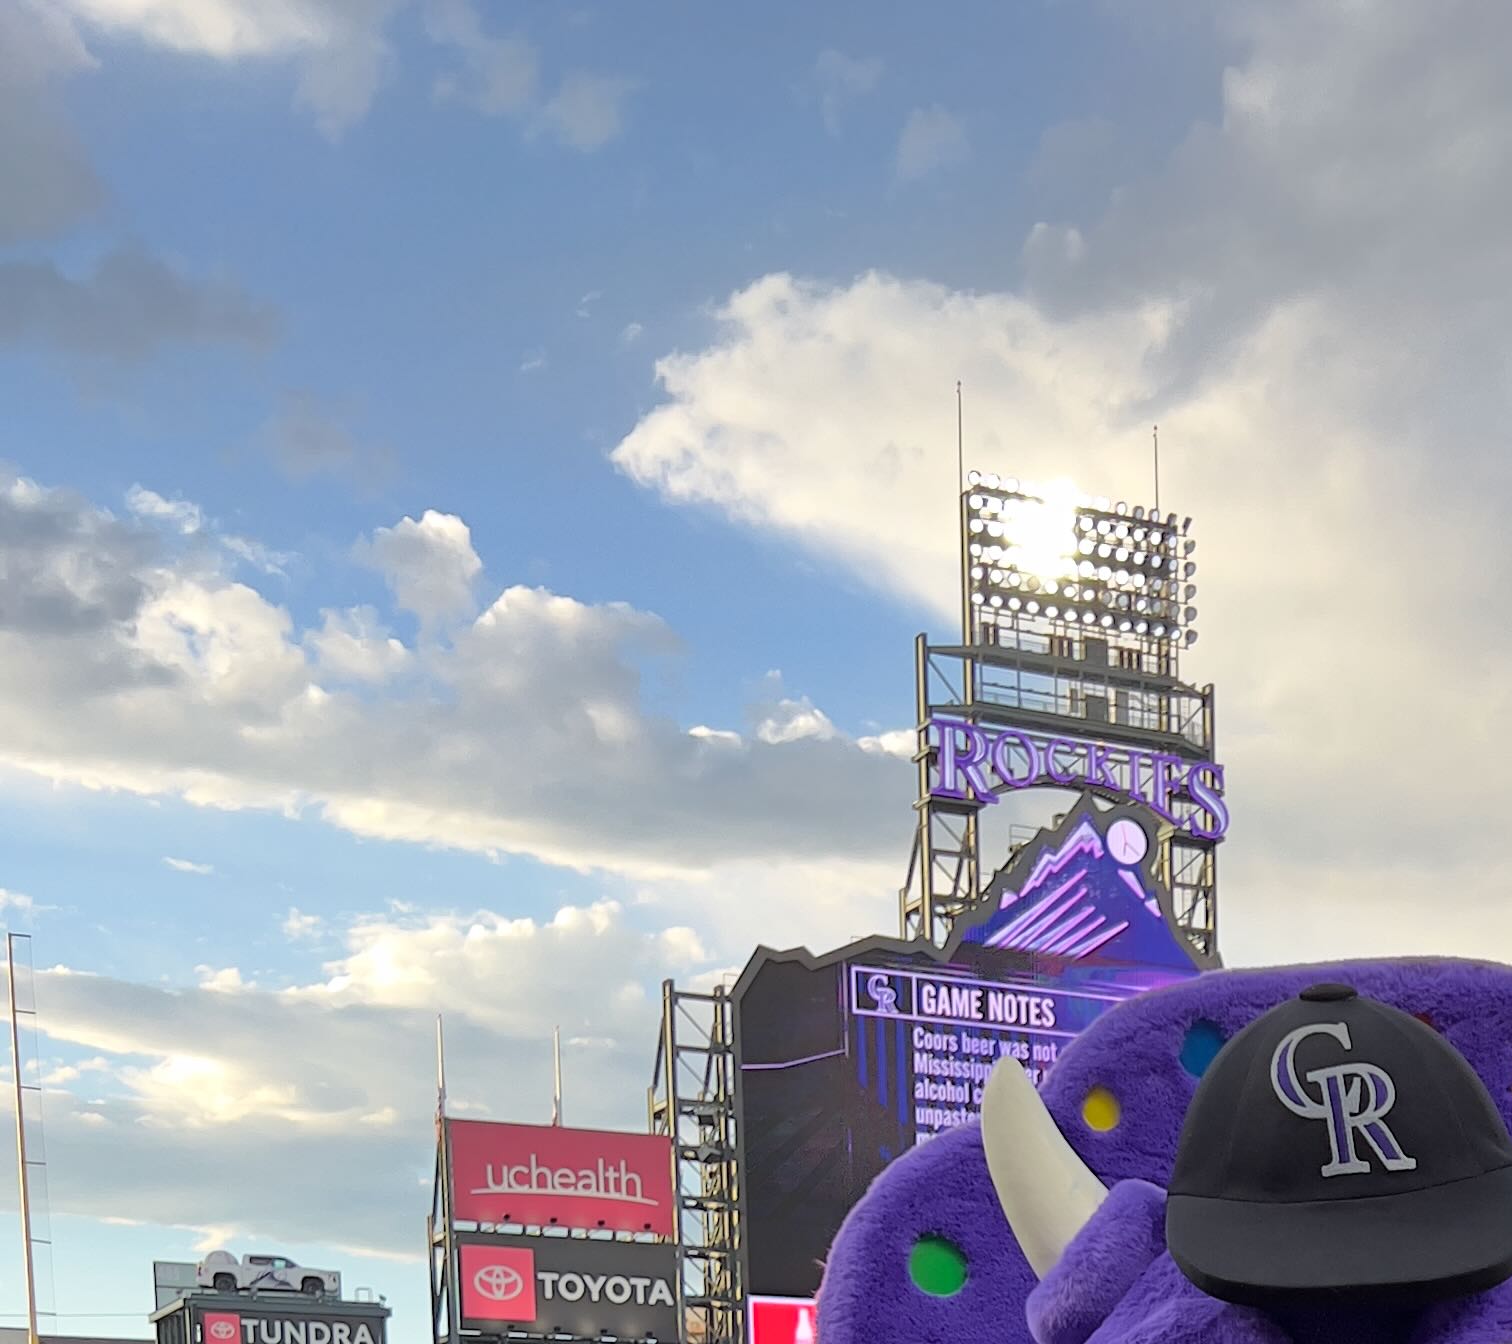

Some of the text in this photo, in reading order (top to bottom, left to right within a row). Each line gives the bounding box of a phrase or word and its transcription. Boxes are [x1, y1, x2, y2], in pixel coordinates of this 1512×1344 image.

[928, 718, 1230, 839] ROCKIES
[922, 984, 1056, 1028] GAME NOTES
[913, 1027, 1058, 1062] Coors beer was not
[914, 1052, 995, 1084] Mississipp
[915, 1080, 970, 1104] alcohol
[916, 1106, 981, 1129] unpaste
[486, 1153, 643, 1200] uchealth
[537, 1271, 675, 1306] TOYOTA
